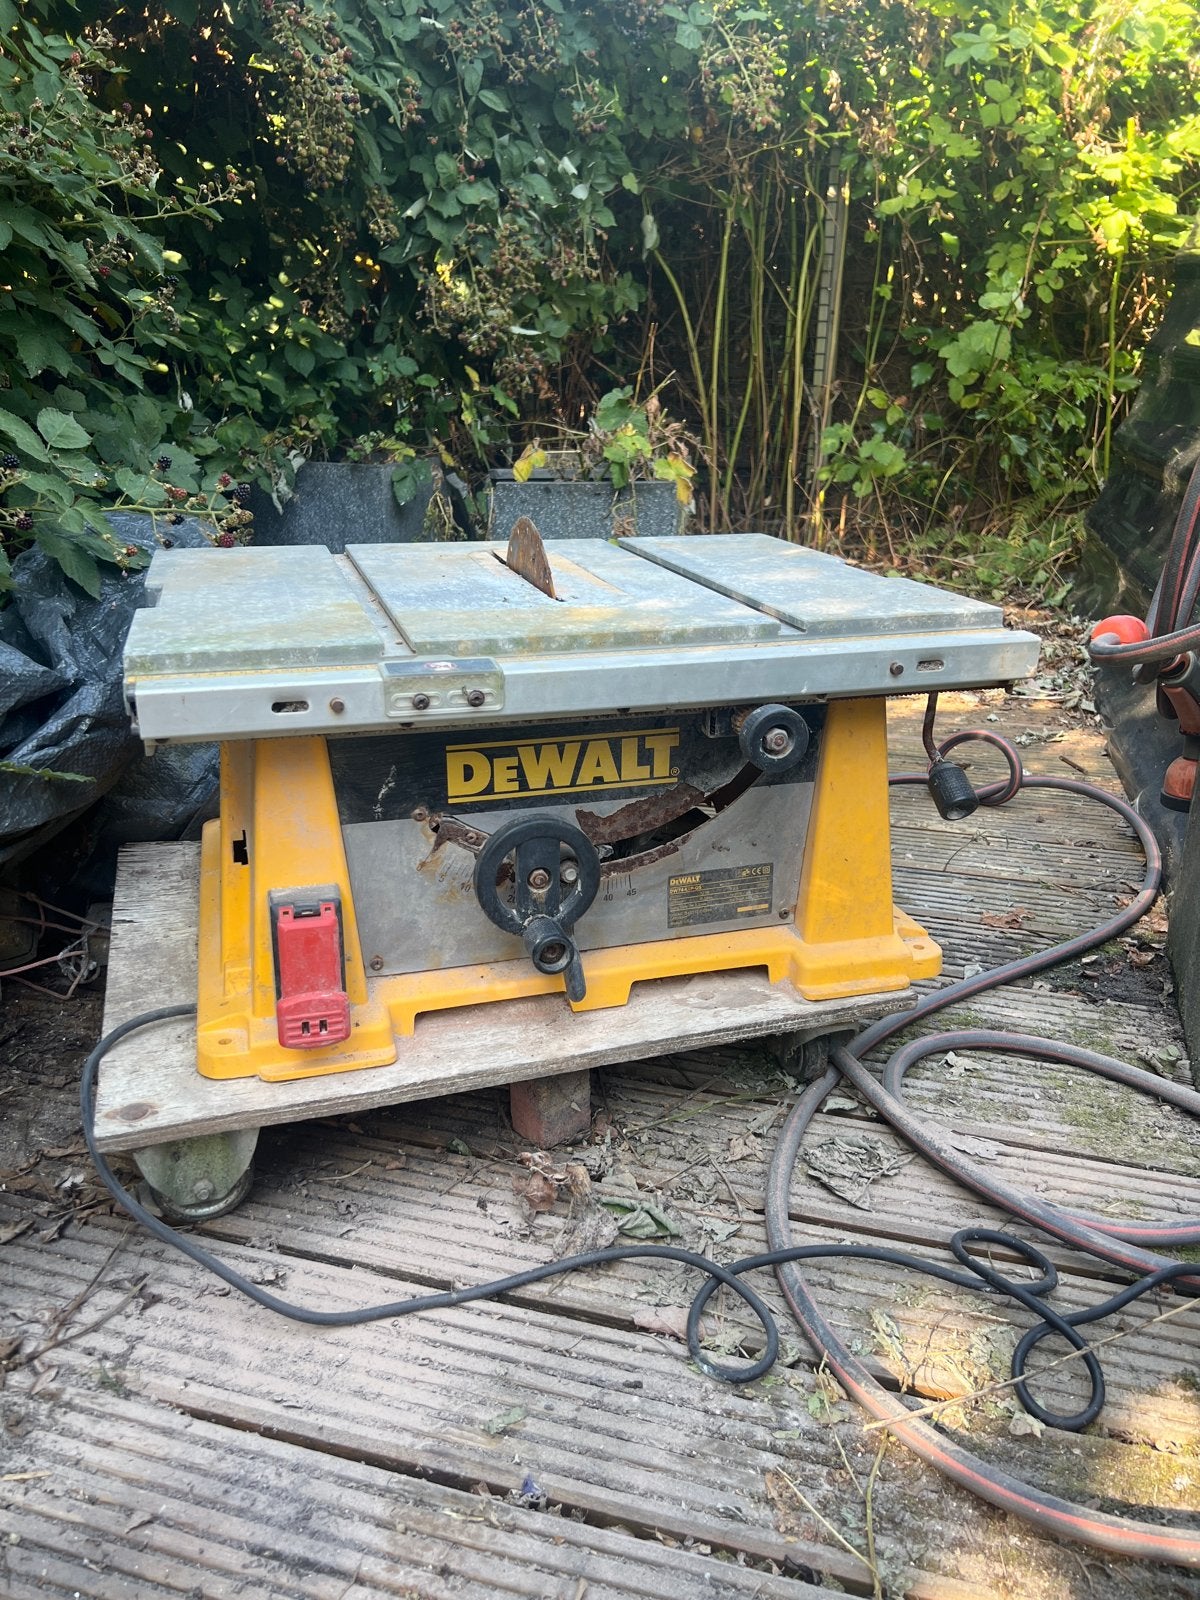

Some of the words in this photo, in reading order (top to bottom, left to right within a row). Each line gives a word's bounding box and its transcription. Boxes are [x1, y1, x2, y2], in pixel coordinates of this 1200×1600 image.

[461, 881, 472, 893] 10
[626, 888, 637, 897] 45
[603, 893, 614, 902] 40
